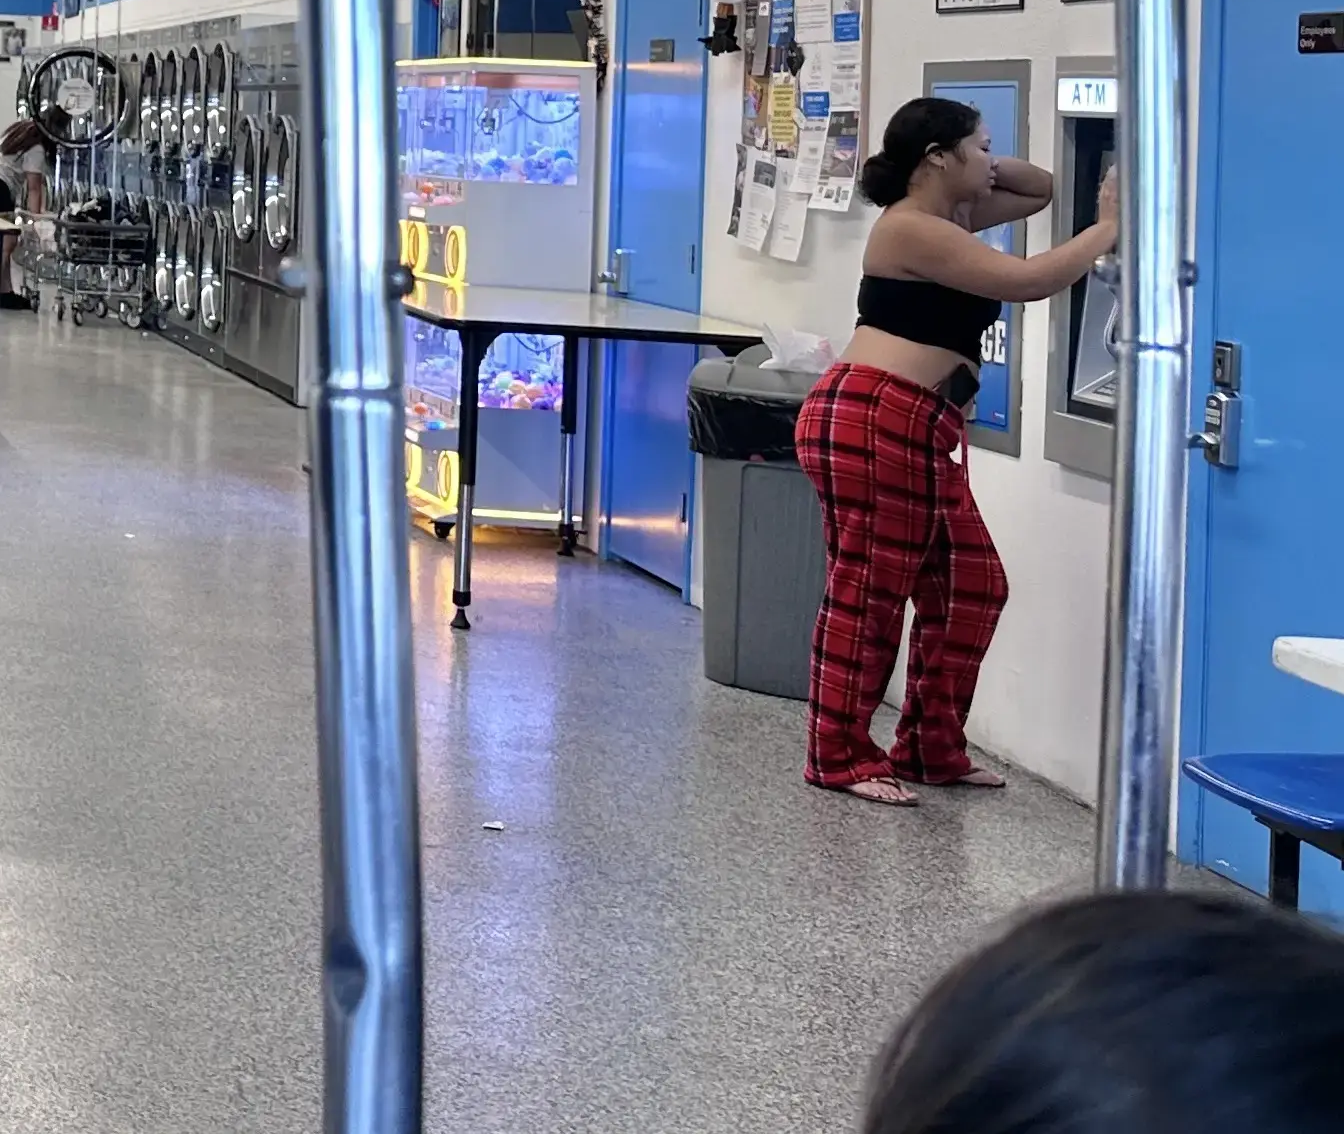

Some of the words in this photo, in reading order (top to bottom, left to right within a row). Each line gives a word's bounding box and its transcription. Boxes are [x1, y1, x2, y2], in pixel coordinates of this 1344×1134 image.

[1301, 26, 1336, 36] Employees
[1300, 38, 1316, 49] Only
[1072, 83, 1105, 106] ATM
[980, 320, 1006, 363] CE
